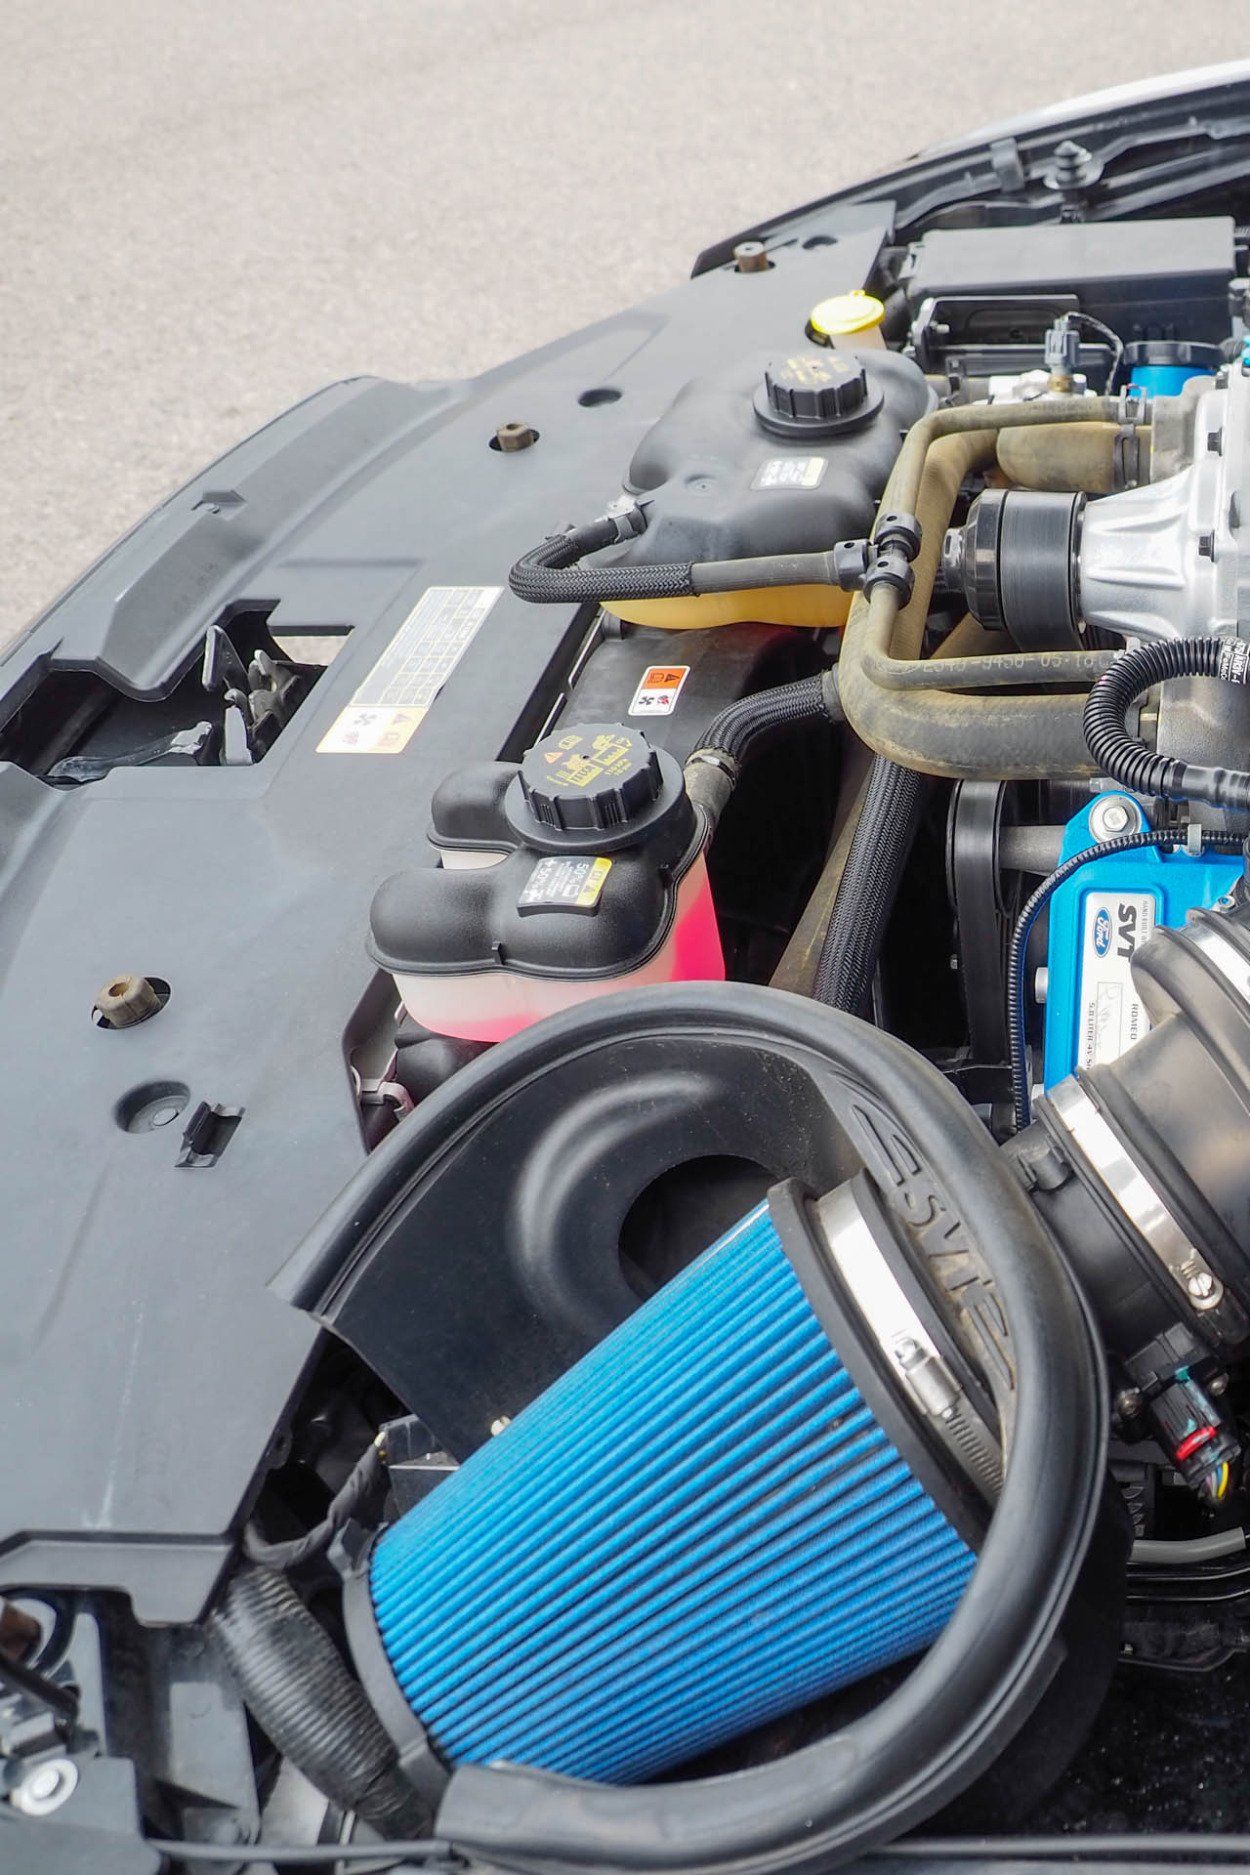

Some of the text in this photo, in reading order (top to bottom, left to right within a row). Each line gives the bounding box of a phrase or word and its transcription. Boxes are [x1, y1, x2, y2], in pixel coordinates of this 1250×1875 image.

[1117, 902, 1138, 963] SVT
[1130, 1003, 1139, 1040] ROMEO
[902, 1189, 996, 1293] SVT
